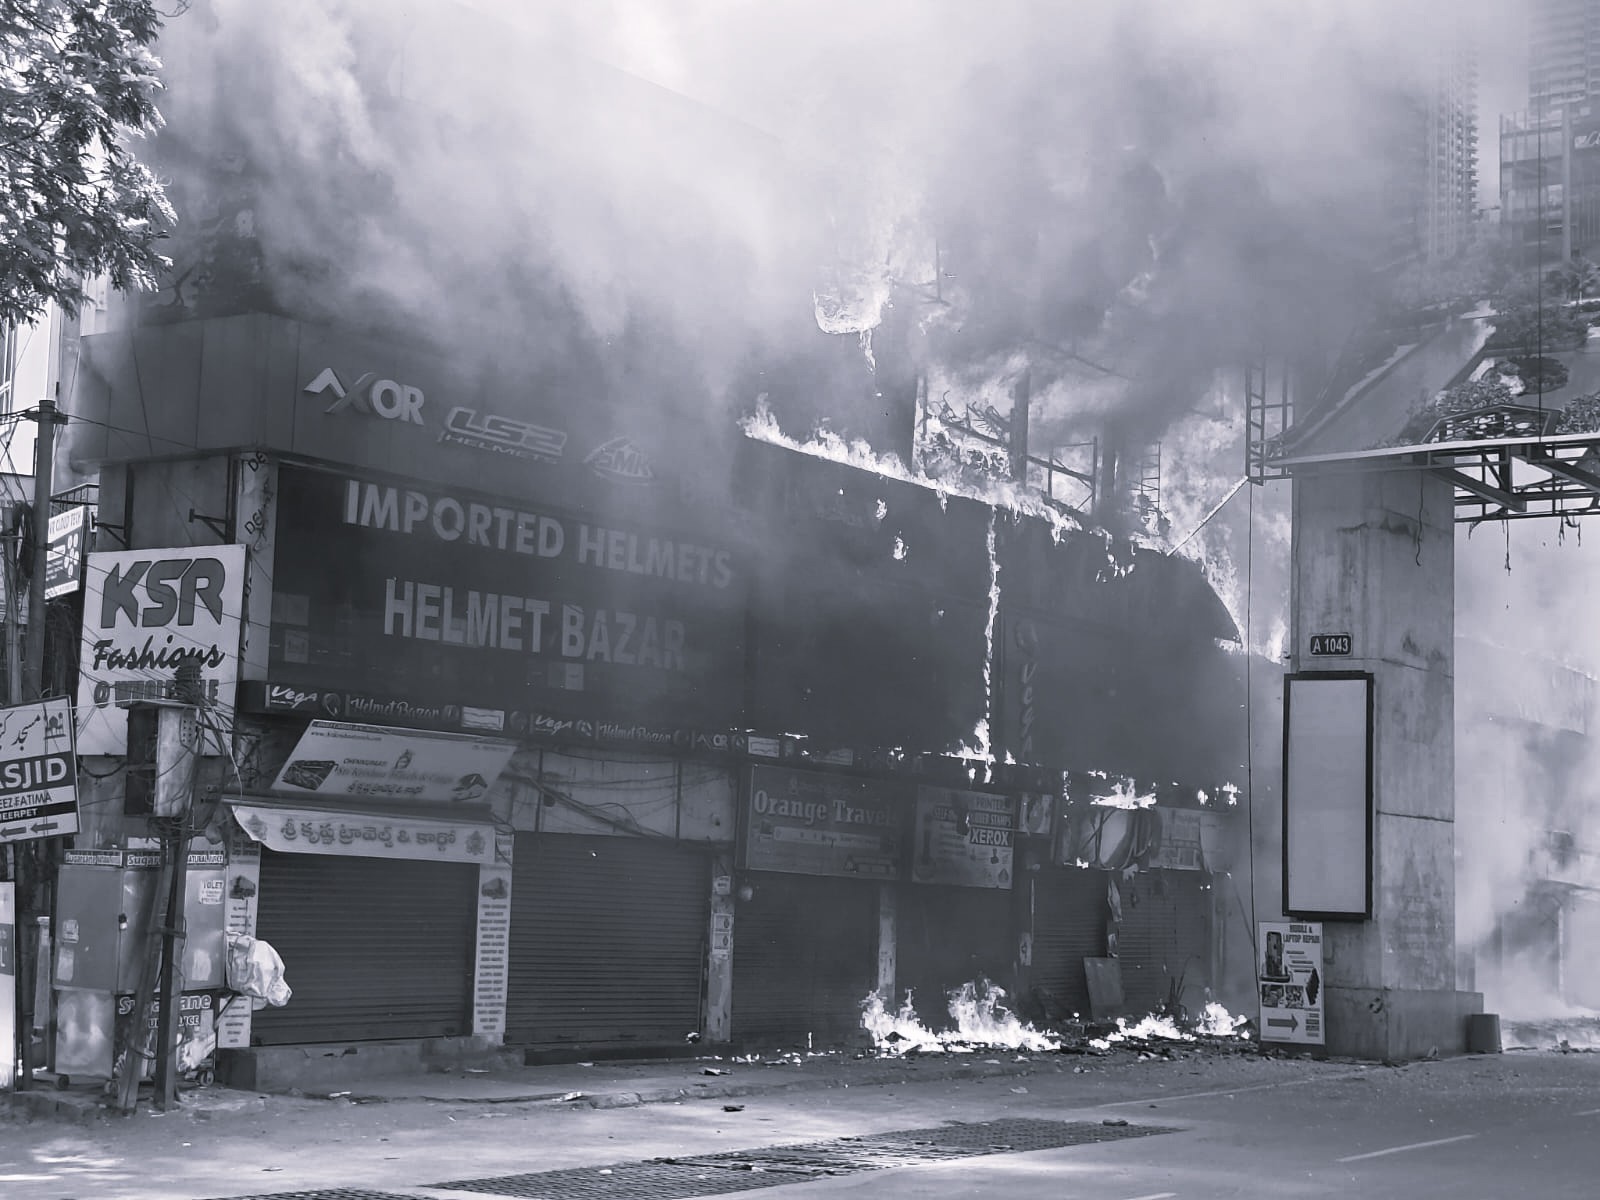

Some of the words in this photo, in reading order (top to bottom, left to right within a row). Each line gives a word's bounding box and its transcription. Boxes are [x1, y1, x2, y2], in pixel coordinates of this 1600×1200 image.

[303, 368, 424, 426] AXOR
[343, 479, 564, 559] IMPORTED
[578, 524, 732, 589] HELMETS
[101, 558, 226, 629] KSR
[384, 578, 550, 653] HELMET
[562, 604, 685, 671] BAZAR
[1312, 638, 1321, 654] A
[1324, 638, 1349, 653] 1043
[351, 696, 395, 717] Helmet
[396, 701, 440, 720] Bazar
[15, 790, 53, 807] FATIMA
[754, 790, 827, 826] Orange
[971, 828, 1009, 846] XEROX
